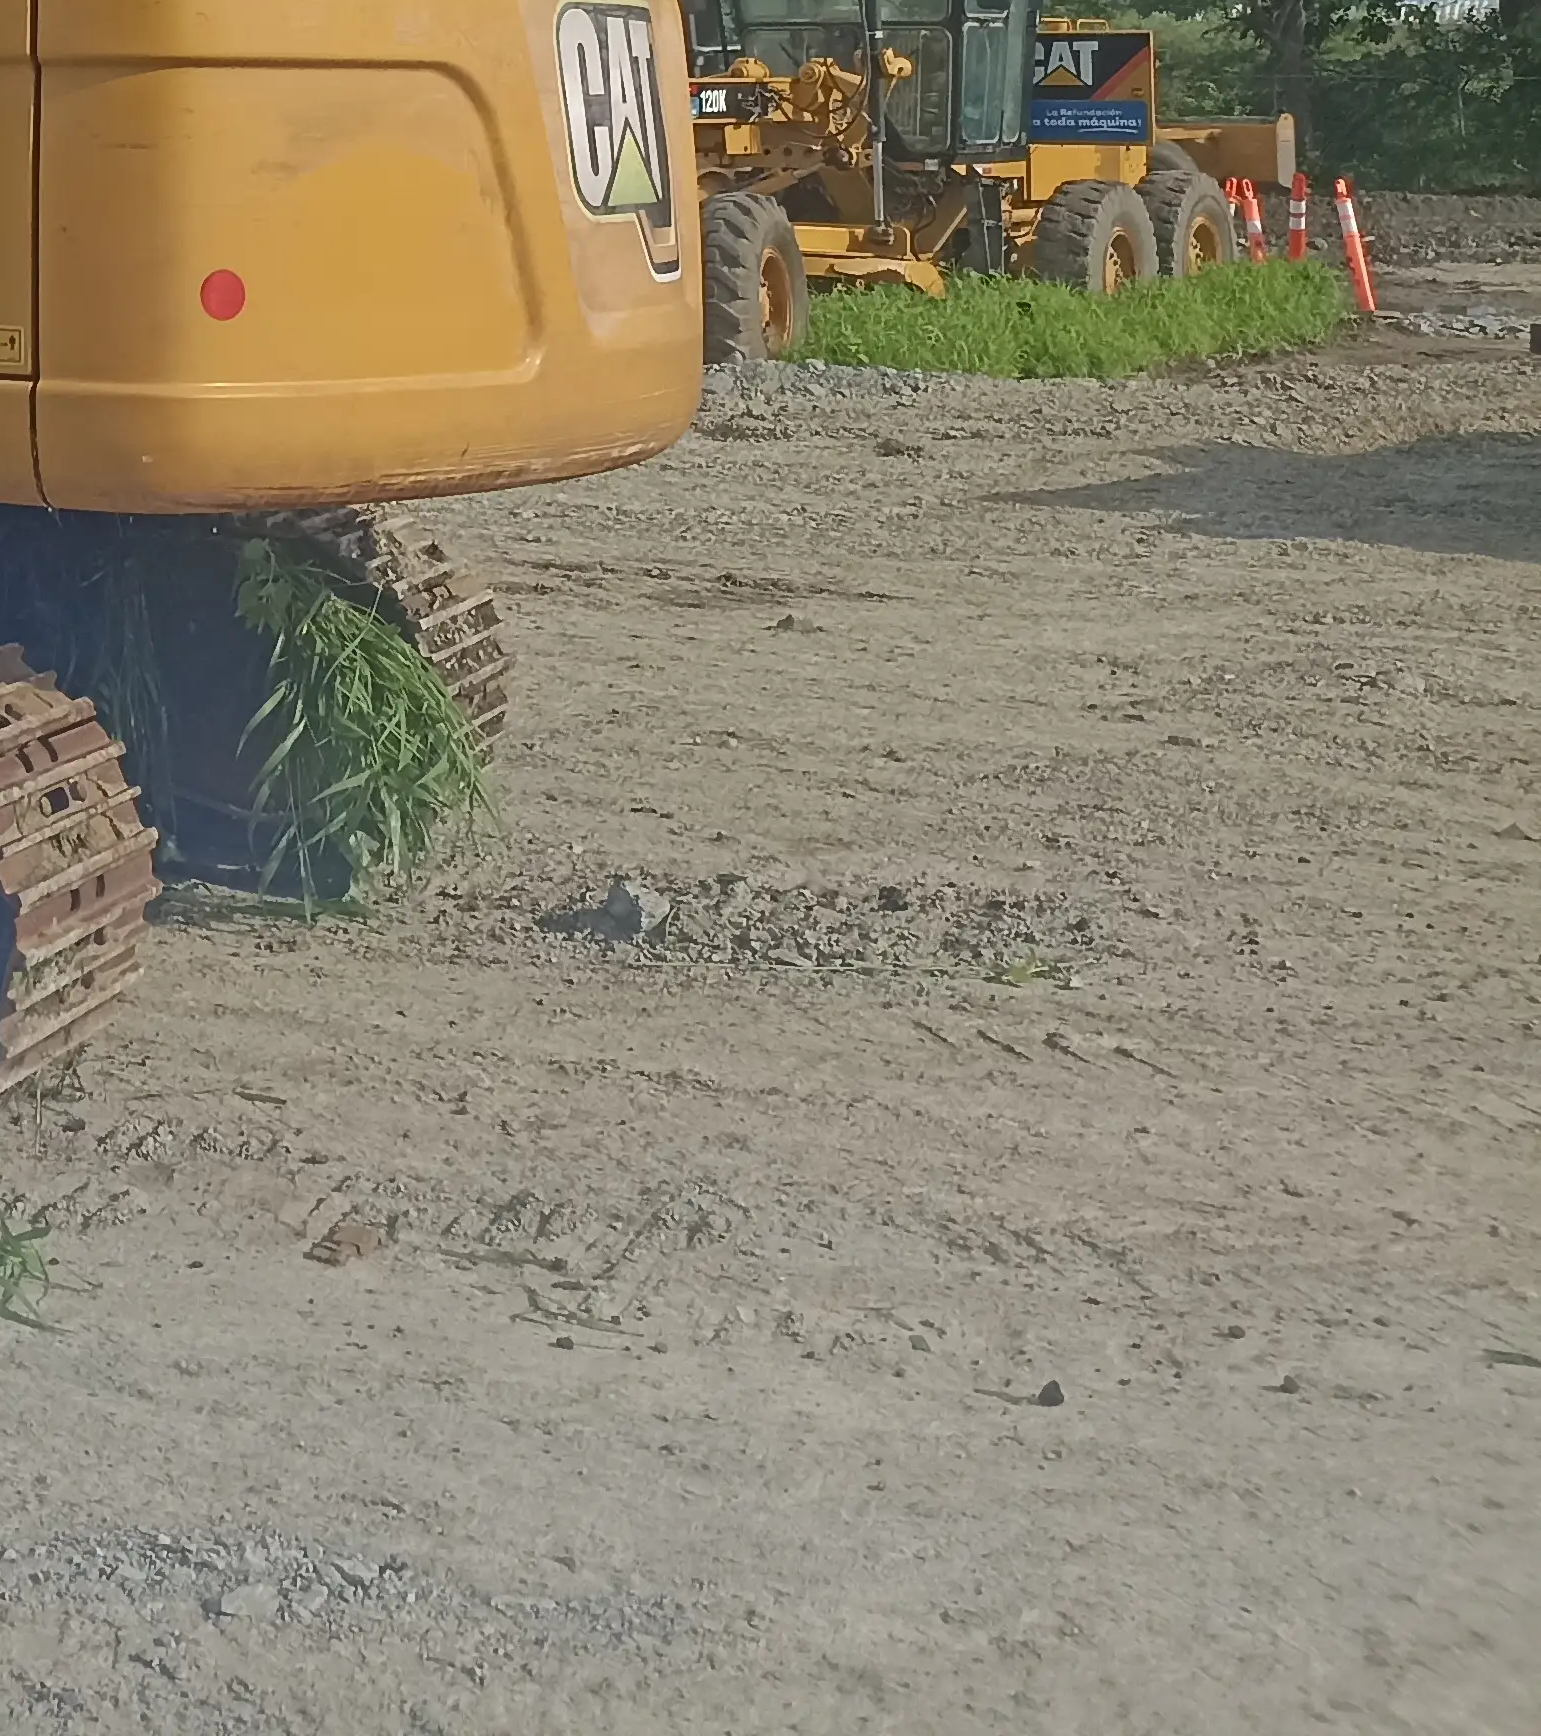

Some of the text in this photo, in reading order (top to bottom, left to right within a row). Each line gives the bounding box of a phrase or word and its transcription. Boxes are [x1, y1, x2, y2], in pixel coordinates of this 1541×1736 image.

[559, 7, 663, 207] CAT
[699, 89, 727, 113] 120K
[1044, 117, 1076, 126] toda
